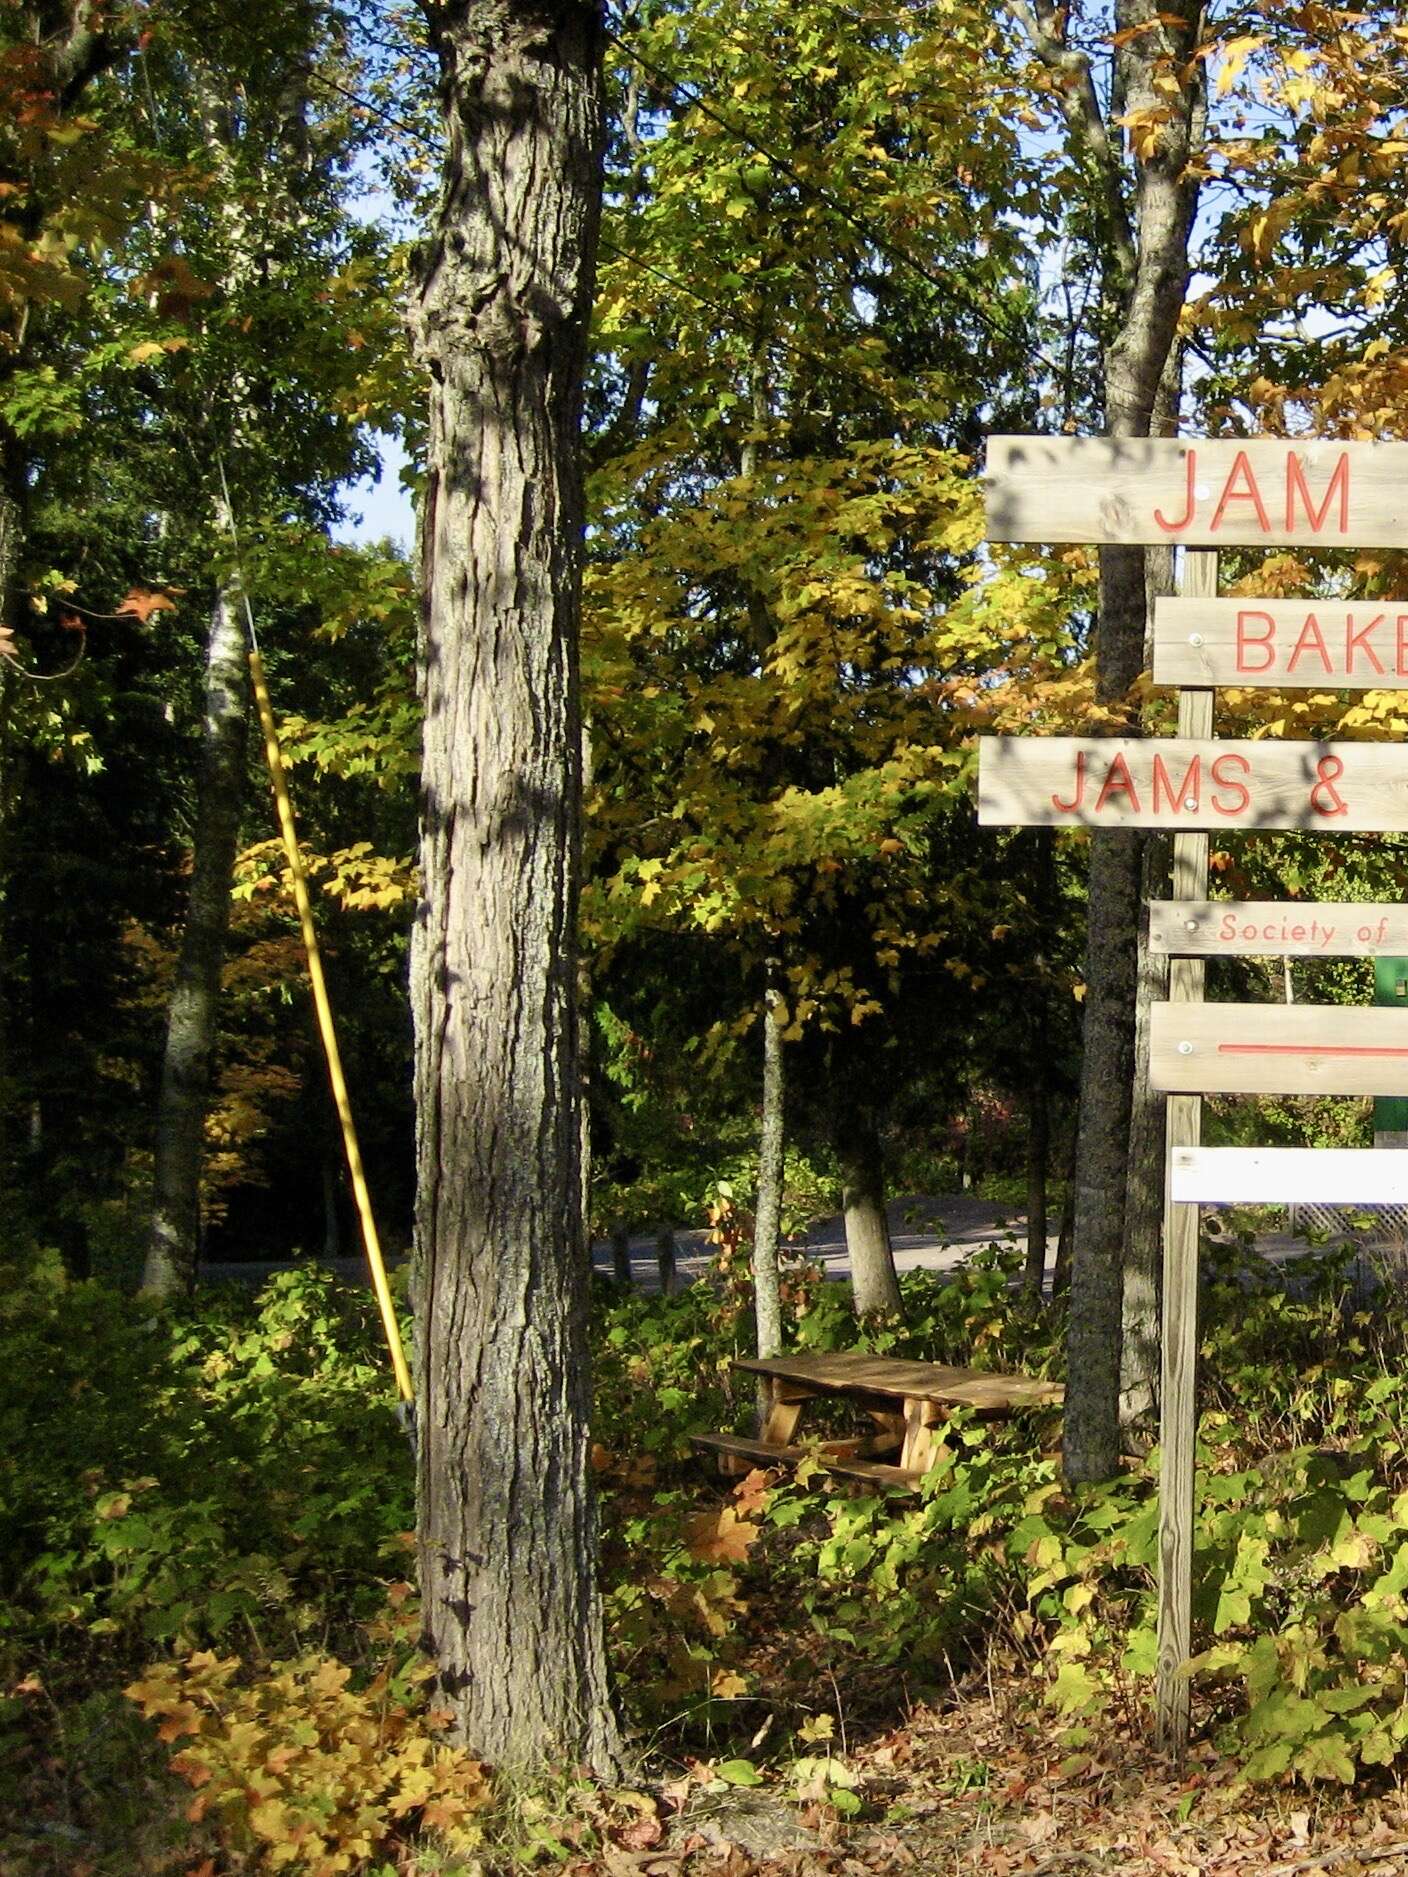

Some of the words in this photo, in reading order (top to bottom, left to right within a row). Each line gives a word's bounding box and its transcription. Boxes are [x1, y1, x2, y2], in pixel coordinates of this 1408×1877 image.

[1153, 448, 1350, 535] JAM
[1051, 751, 1252, 817] JAMS
[1309, 754, 1350, 818] &
[1218, 913, 1336, 949] Society
[1357, 915, 1389, 944] of
